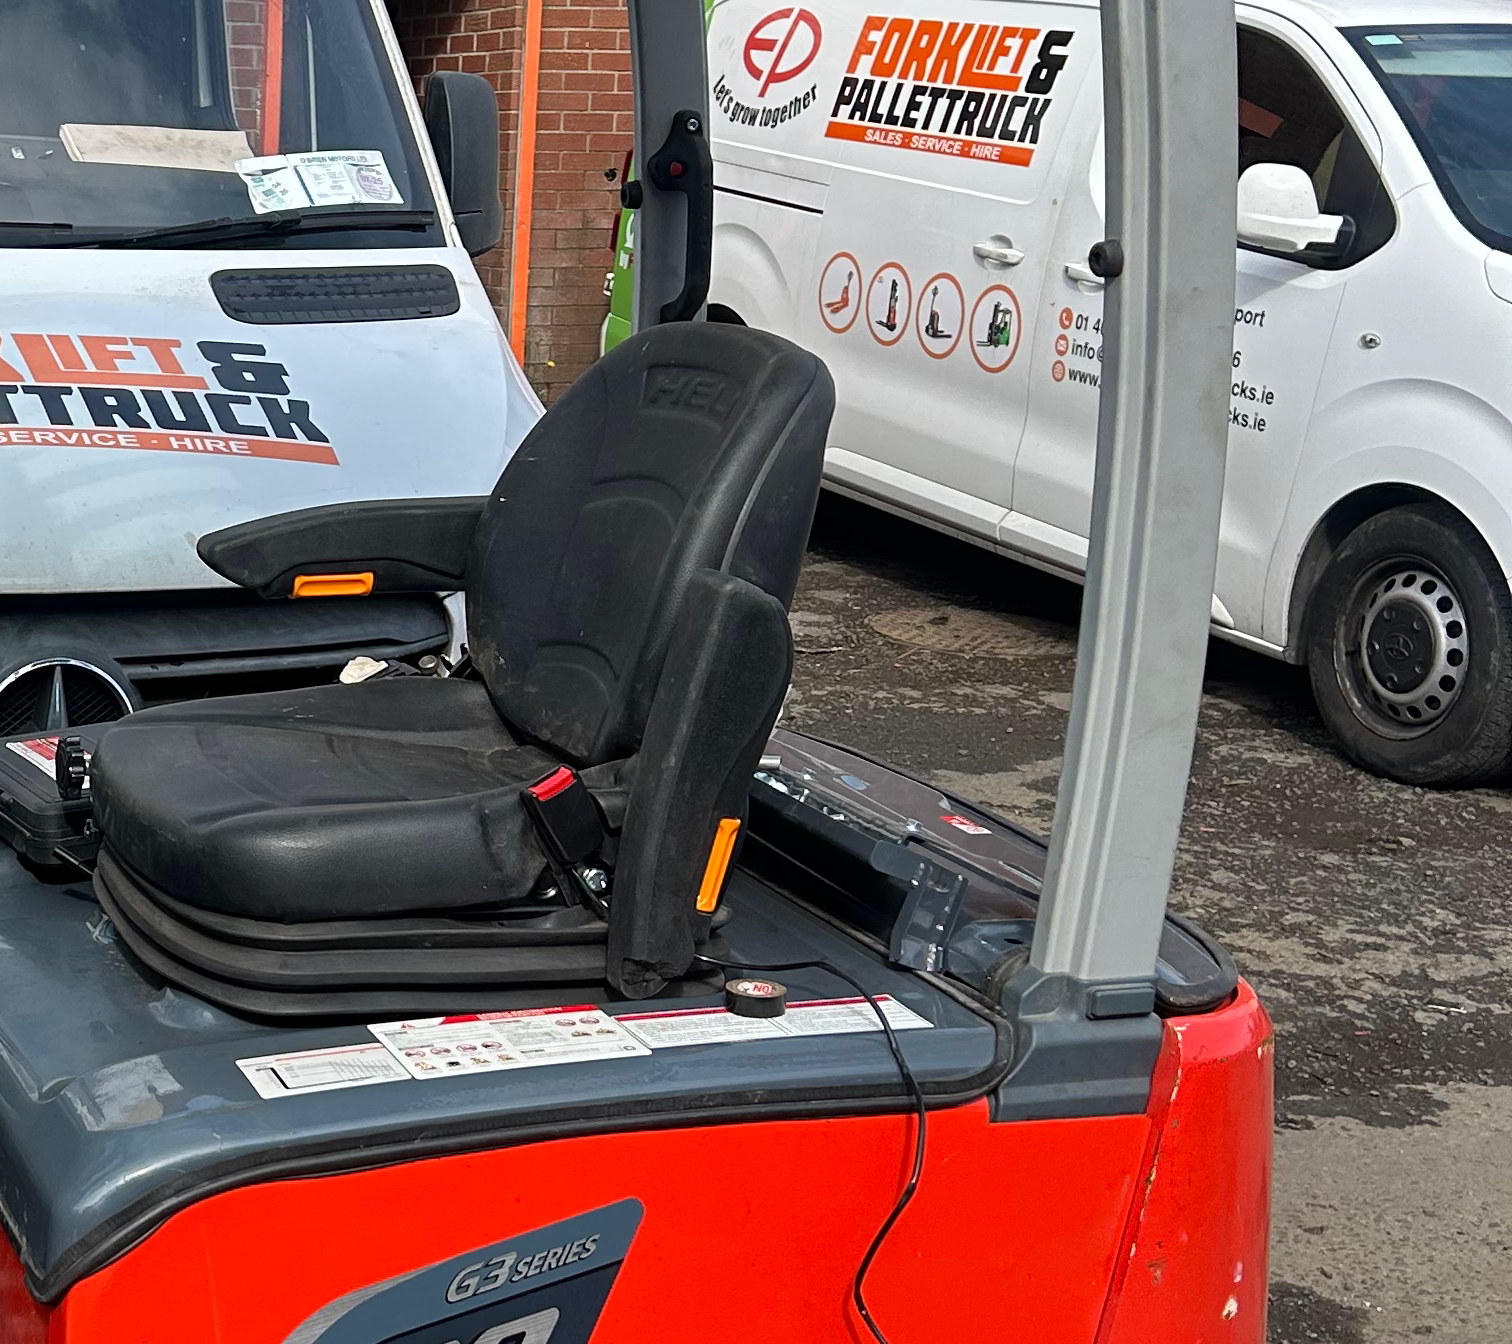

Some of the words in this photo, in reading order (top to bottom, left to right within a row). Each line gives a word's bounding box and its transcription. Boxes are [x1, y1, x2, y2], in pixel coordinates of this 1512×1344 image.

[845, 15, 1042, 93] FORKLIFT
[1024, 30, 1076, 95] &
[729, 100, 761, 127] grow
[758, 83, 818, 129] together
[831, 76, 1053, 145] PALLETTRUCK
[864, 129, 904, 146] SALES
[909, 135, 964, 154] SERVICE
[970, 145, 1002, 160] HIRE
[1075, 313, 1089, 331] 01
[1093, 318, 1104, 335] 4
[197, 339, 291, 396] &
[170, 436, 252, 455] HIRE
